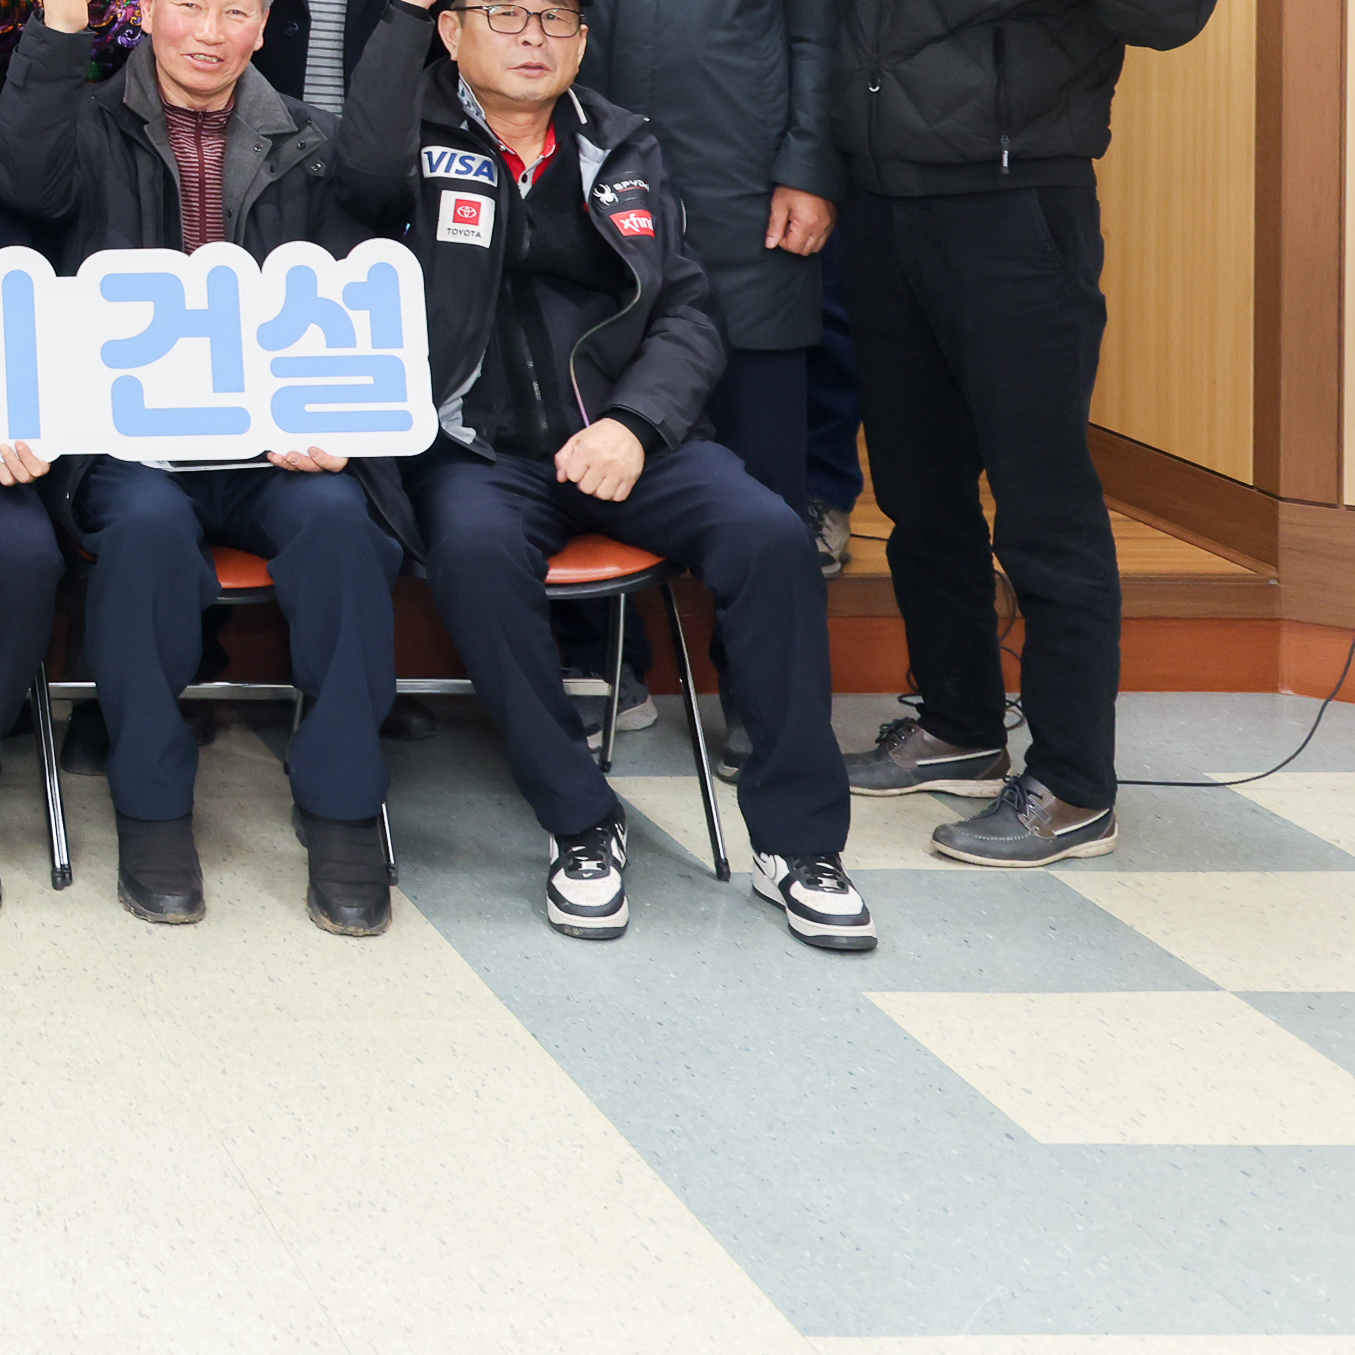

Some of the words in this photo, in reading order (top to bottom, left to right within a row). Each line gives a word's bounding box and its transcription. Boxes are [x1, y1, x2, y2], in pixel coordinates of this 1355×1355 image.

[424, 151, 495, 182] VISA
[447, 228, 482, 238] TOYOTA
[100, 262, 414, 438] 건설
